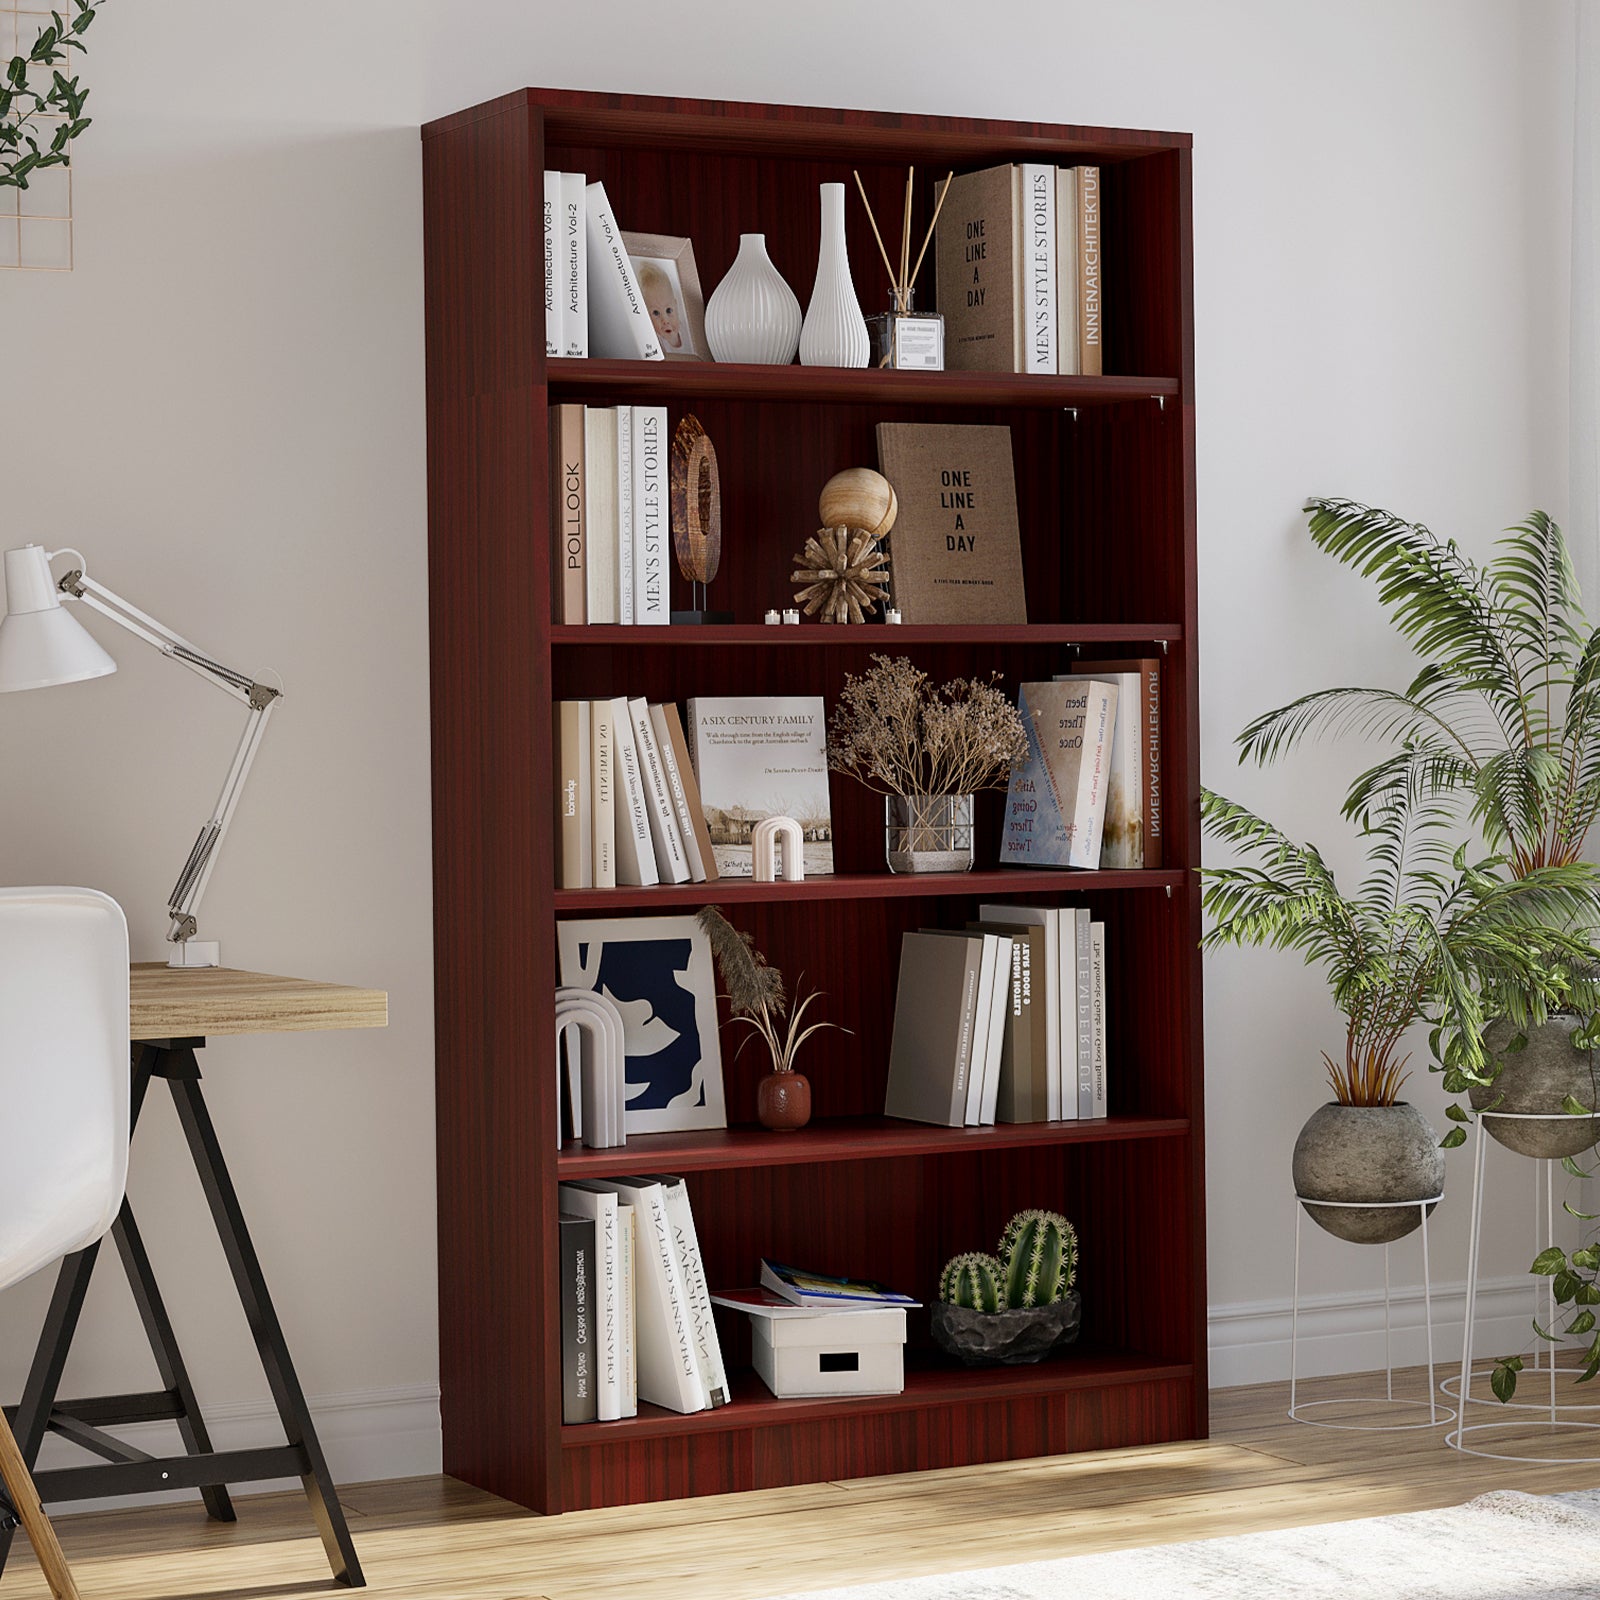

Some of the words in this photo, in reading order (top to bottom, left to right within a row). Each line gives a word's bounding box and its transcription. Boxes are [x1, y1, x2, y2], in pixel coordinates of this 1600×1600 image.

[544, 202, 552, 235] Vol-3
[568, 203, 577, 235] Vol-2
[598, 213, 614, 244] Vol-1
[966, 220, 985, 240] ONE
[1034, 174, 1047, 248] STORIES
[544, 238, 553, 311] Architecture
[966, 243, 987, 262] LINE
[973, 266, 979, 283] A
[1084, 167, 1098, 345] INNENARCHITEKTUR
[569, 240, 578, 313] Architecture
[612, 246, 640, 315] Architecture
[967, 288, 985, 308] DAY
[1035, 252, 1048, 307] STYLE
[1036, 311, 1049, 365] MEN'S
[621, 412, 631, 501] REVOLUTION
[644, 417, 658, 492] STORIES
[941, 471, 971, 487] ONE
[941, 492, 975, 508] LINE
[566, 462, 581, 569] POLLOCK
[622, 506, 631, 544] LOOK
[645, 497, 659, 553] STYLE
[955, 514, 965, 530] A
[623, 550, 632, 578] NEW
[946, 536, 976, 552] DAY
[646, 556, 660, 612] MEN'S
[710, 717, 726, 725] SIX
[728, 716, 775, 725] CENTURY
[777, 716, 815, 724] FAMILY
[605, 1206, 613, 1292] GRÜTZKE
[651, 1200, 673, 1282] GRÜTZKE
[576, 1314, 587, 1344] Сказки
[607, 1292, 616, 1386] JOHANNES
[668, 1285, 694, 1376] JOHANNES
[577, 1378, 587, 1398] Анна
